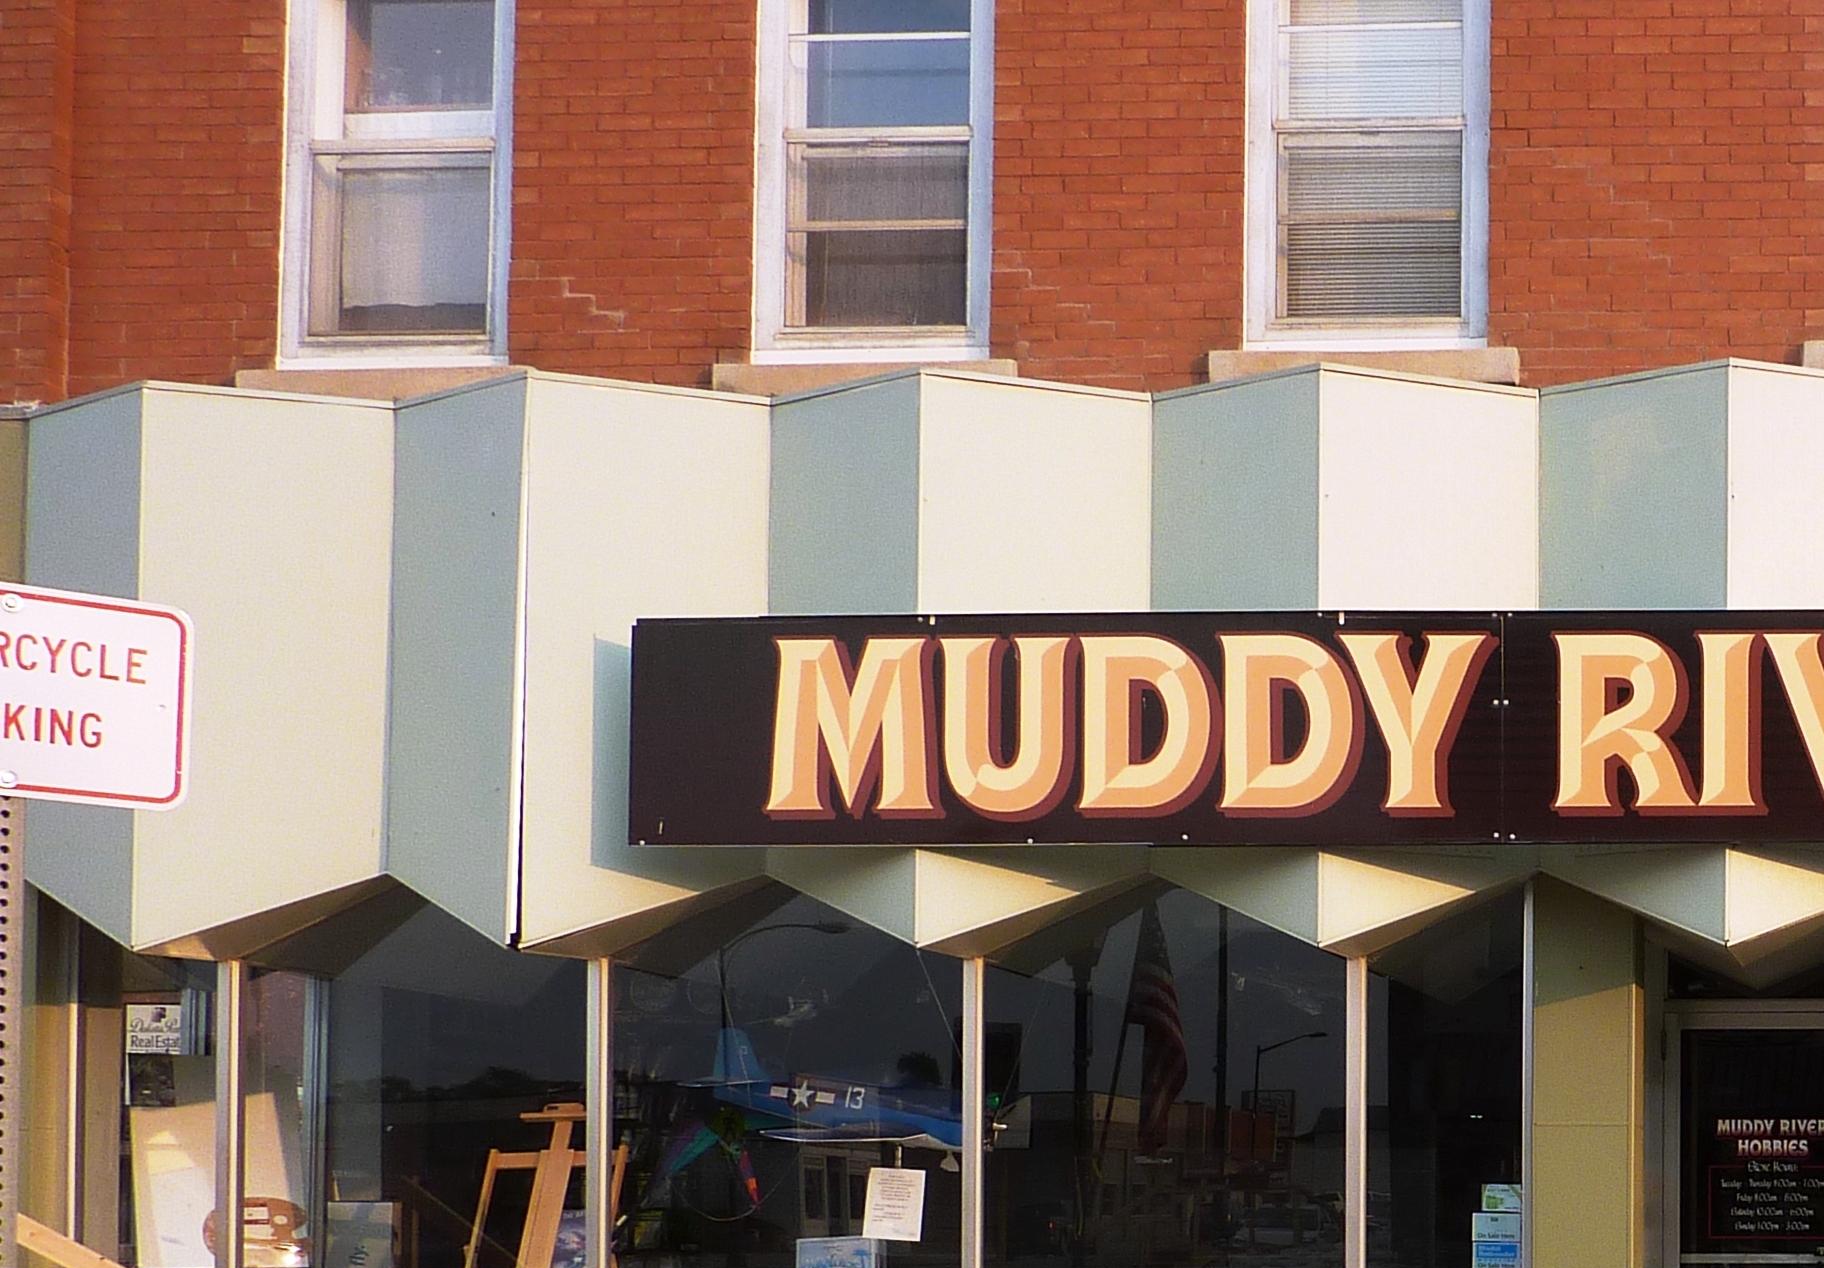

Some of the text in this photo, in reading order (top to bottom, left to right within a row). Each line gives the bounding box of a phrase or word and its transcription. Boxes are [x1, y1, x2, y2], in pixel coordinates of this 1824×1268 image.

[3, 702, 104, 749] KING
[763, 630, 1494, 821] MUDDY
[131, 1035, 154, 1049] Real
[845, 1085, 866, 1110] 13
[1717, 1119, 1774, 1136] MUDDY
[1738, 1139, 1809, 1156] HOBBIES
